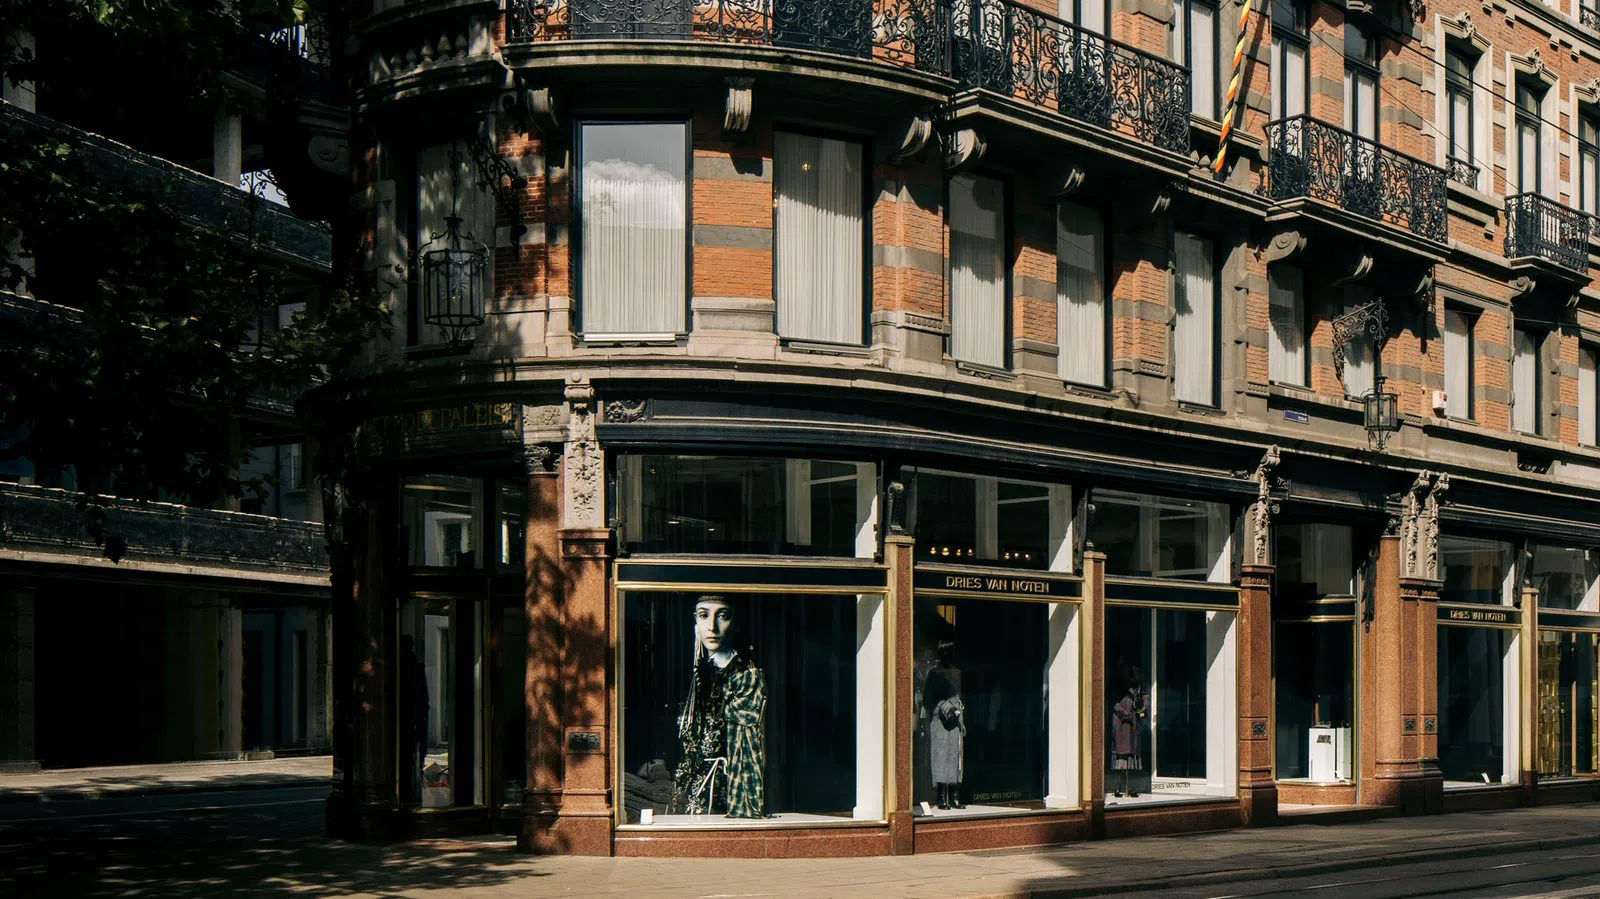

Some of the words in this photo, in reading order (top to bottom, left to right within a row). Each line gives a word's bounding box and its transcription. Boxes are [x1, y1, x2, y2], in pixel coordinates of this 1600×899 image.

[945, 575, 982, 589] DRIES
[985, 578, 1007, 591] VAN
[1011, 580, 1050, 593] NOTEN
